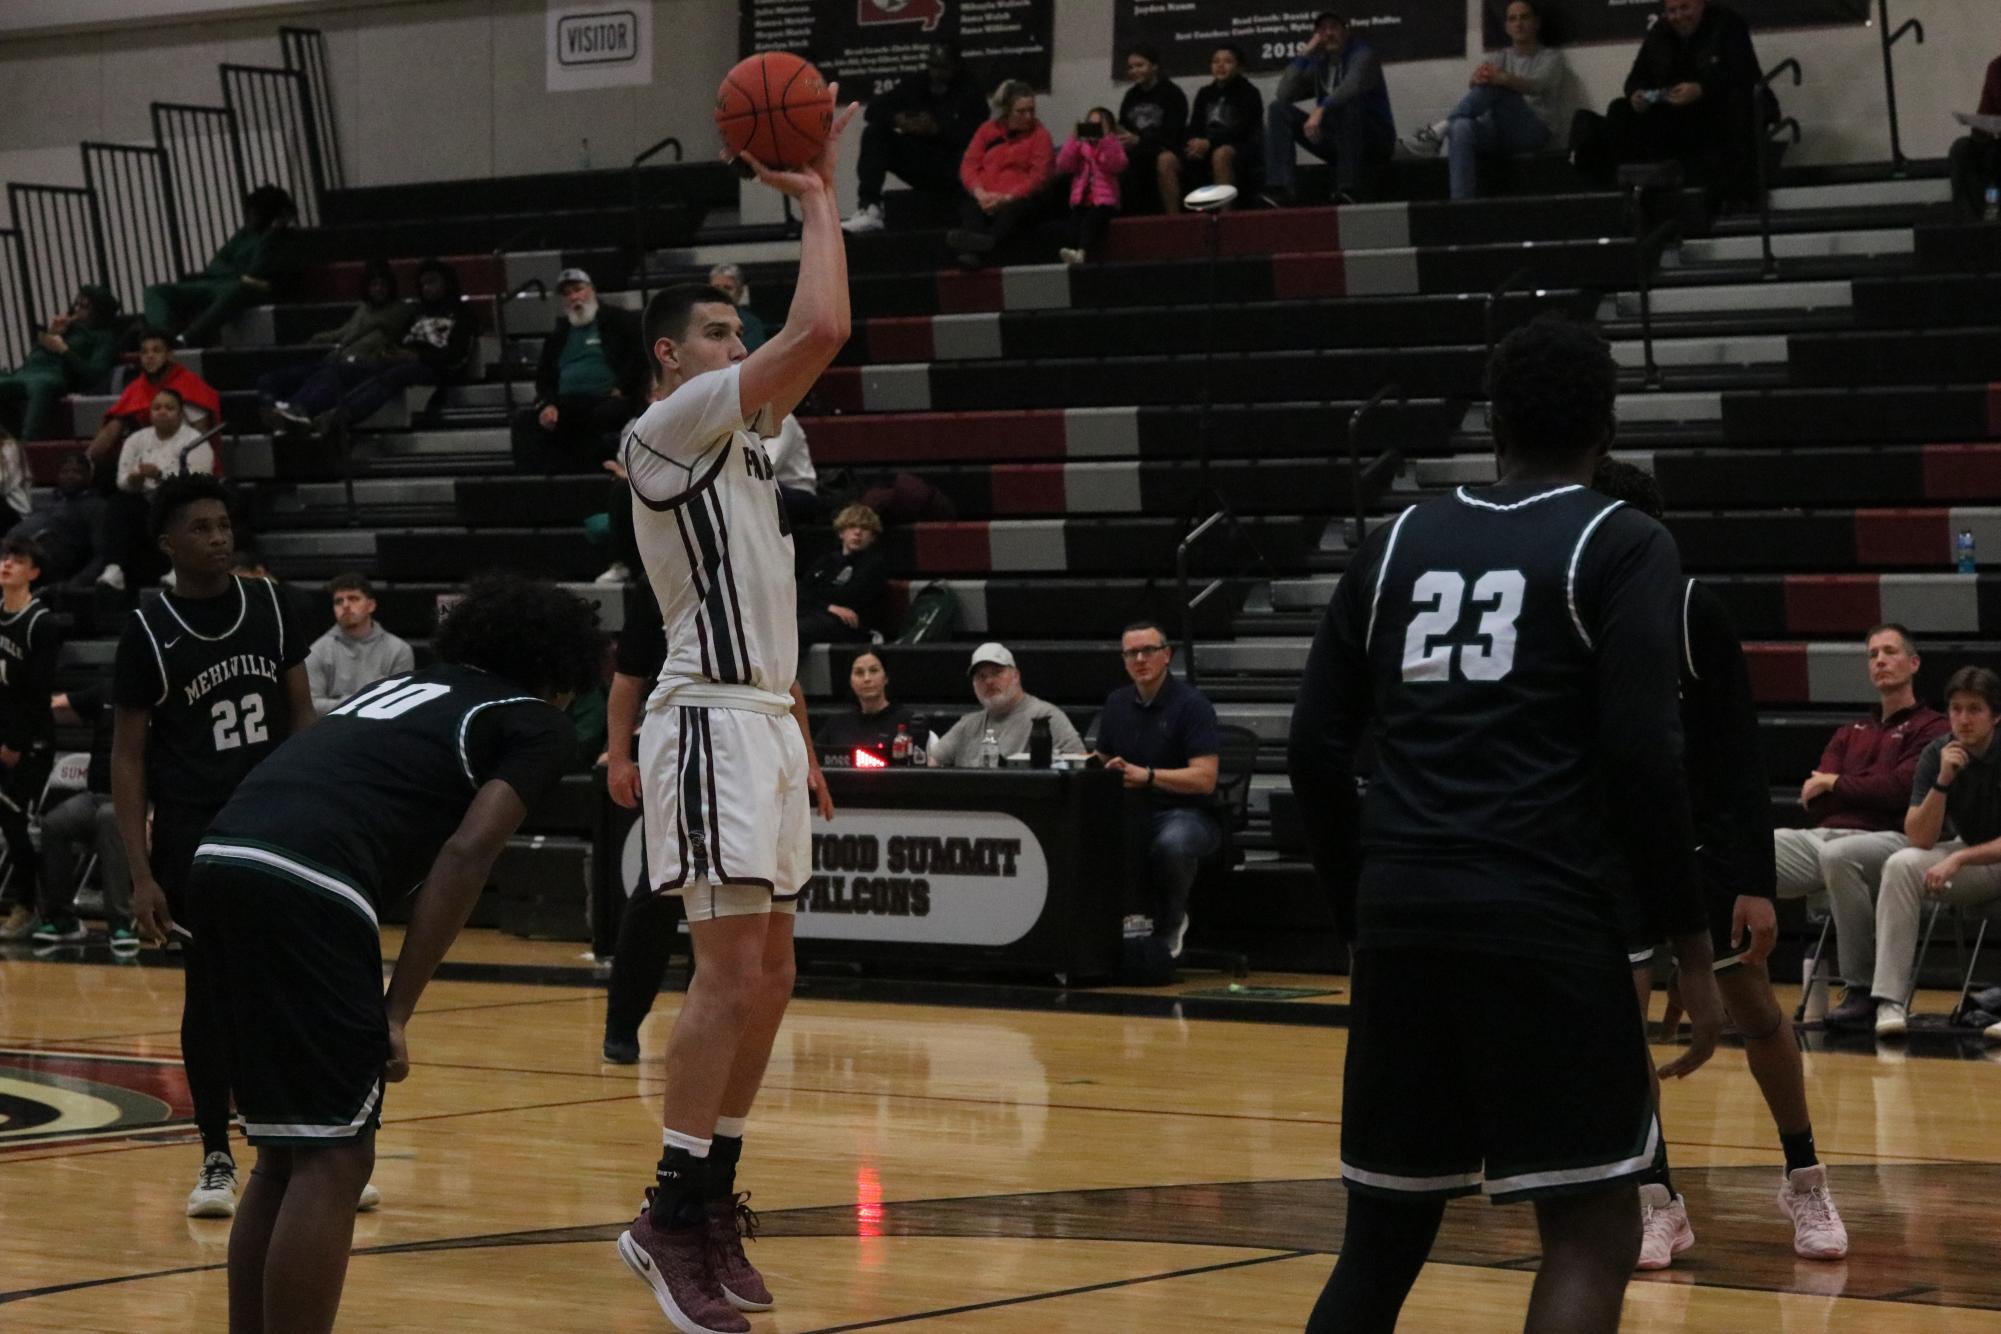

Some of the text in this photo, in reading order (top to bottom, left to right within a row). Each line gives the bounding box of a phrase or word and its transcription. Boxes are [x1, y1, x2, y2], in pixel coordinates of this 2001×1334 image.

[567, 23, 627, 53] VISITOR
[1401, 569, 1526, 682] 23
[326, 676, 452, 720] 10
[210, 692, 269, 752] 22
[887, 835, 1021, 877] SUMMIT
